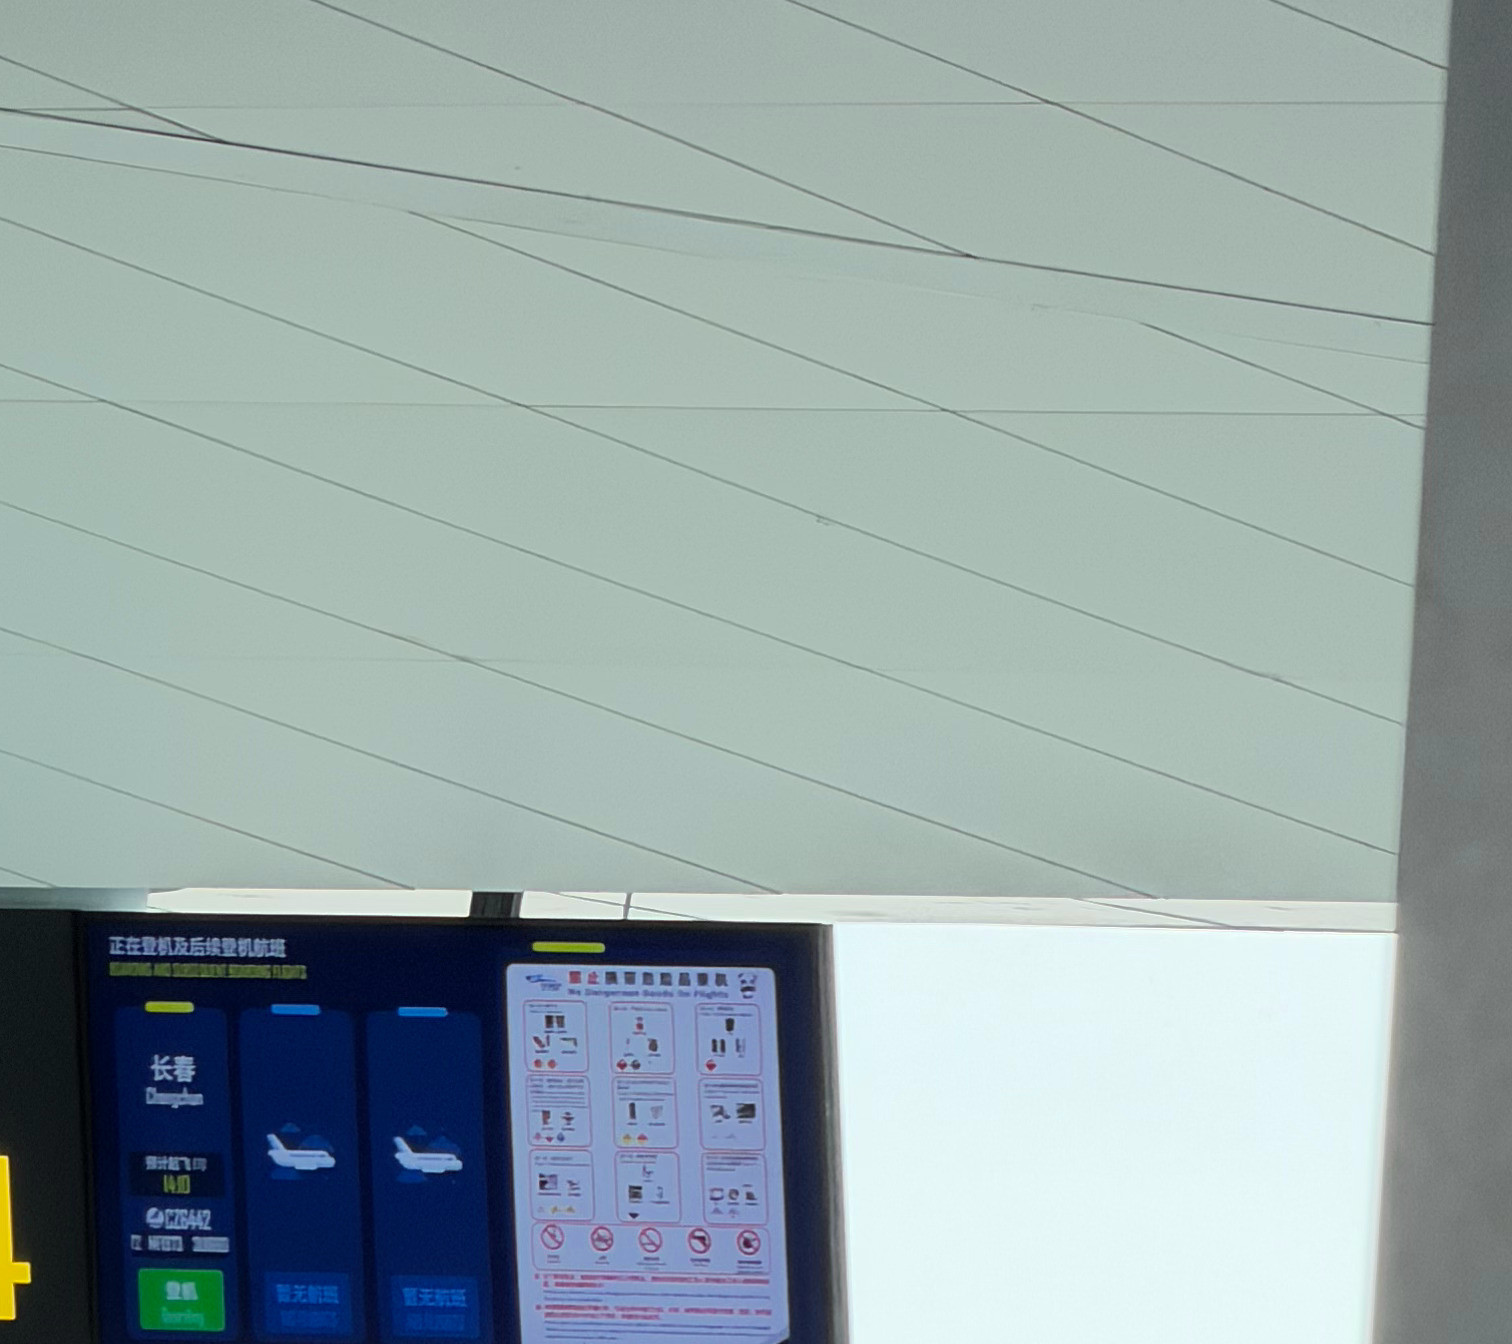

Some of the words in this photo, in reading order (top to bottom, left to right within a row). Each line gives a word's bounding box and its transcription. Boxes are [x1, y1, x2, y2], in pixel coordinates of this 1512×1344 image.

[109, 936, 287, 958] 正在登机及后续登机航班
[150, 1054, 196, 1082] 长春
